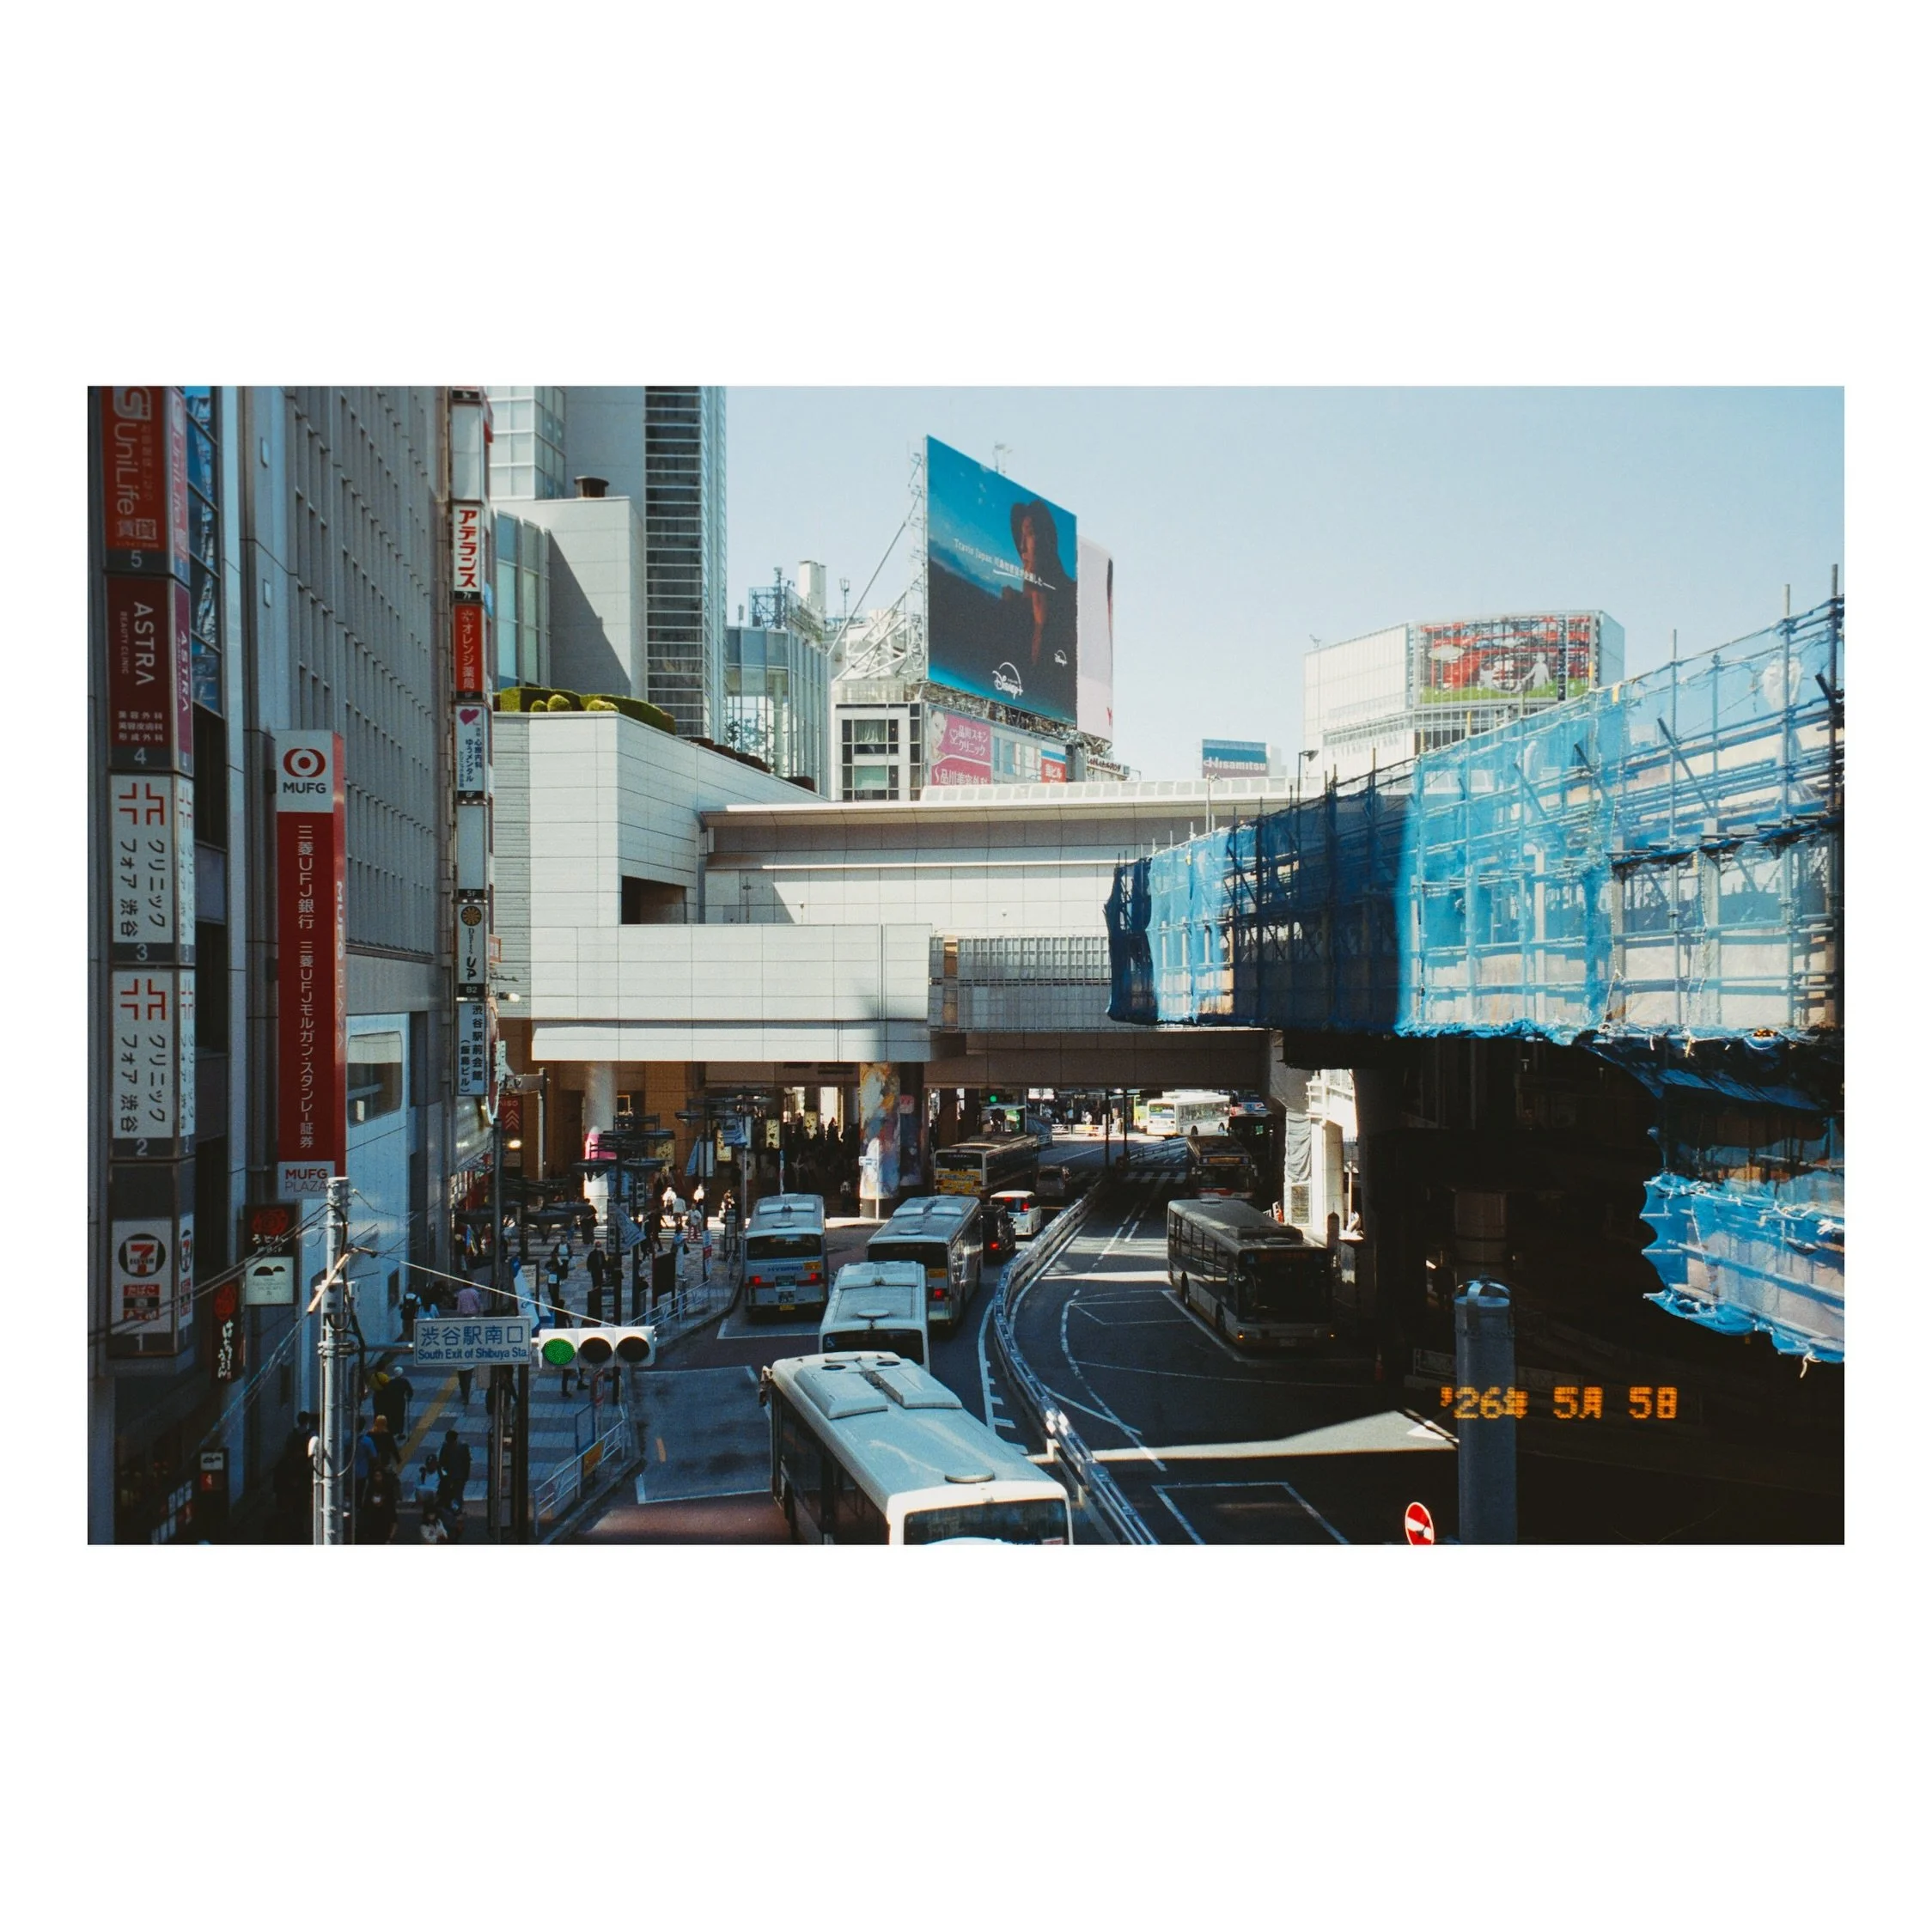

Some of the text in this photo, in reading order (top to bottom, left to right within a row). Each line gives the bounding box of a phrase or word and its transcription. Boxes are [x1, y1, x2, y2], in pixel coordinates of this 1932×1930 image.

[114, 423, 139, 514] UniLife
[457, 510, 477, 587] アデランス
[131, 551, 142, 568] 5
[134, 601, 155, 685] ASTRA
[462, 624, 474, 689] オレンジ薬局
[180, 630, 189, 711] ASTRA
[958, 725, 988, 742] 品川スキン
[134, 747, 147, 765] 4
[959, 740, 985, 756] クリニック
[1204, 756, 1266, 770] Hisamitsu
[283, 782, 326, 794] MUFG
[148, 839, 166, 928] クリニック
[298, 825, 314, 929] 三菱UFJ銀行
[136, 944, 148, 961] 3
[472, 1005, 483, 1081] 渋谷駅前会館
[149, 1034, 166, 1123] クリニック
[137, 1138, 148, 1156] 2
[285, 1169, 327, 1179] MUFG
[285, 1180, 328, 1192] PLAZA
[136, 1334, 143, 1351] 1
[420, 1324, 523, 1347] 渋谷駅南口
[417, 1349, 443, 1360] South
[445, 1349, 463, 1360] Exit
[465, 1349, 472, 1359] of
[475, 1348, 510, 1360] Shibuya
